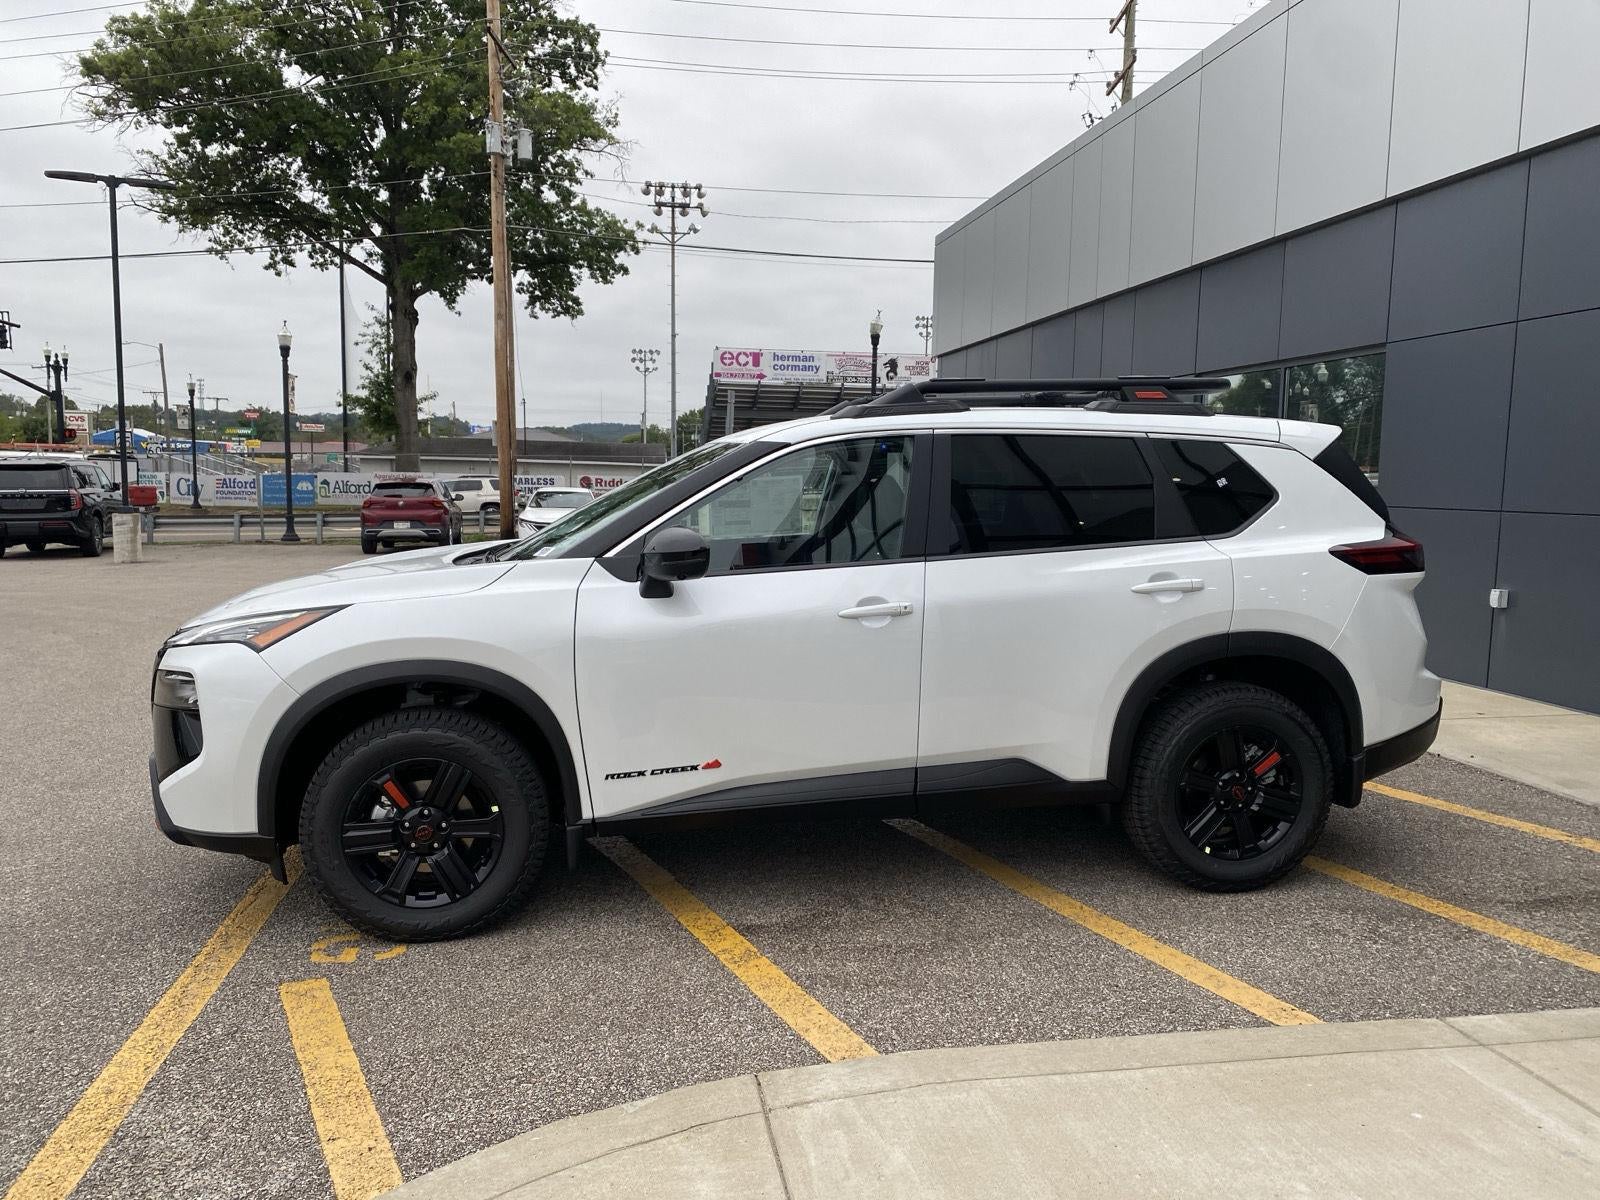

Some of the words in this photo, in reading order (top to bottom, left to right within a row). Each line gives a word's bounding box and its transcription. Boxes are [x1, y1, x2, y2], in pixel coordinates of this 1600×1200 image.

[773, 352, 815, 363] herman
[772, 363, 821, 375] cormany
[148, 446, 162, 455] 60
[221, 478, 256, 489] Alford
[332, 480, 372, 494] Alford
[514, 477, 555, 486] ARLESS
[594, 477, 629, 488] Ridd
[604, 770, 648, 780] ROCK
[650, 764, 701, 776] CREEK
